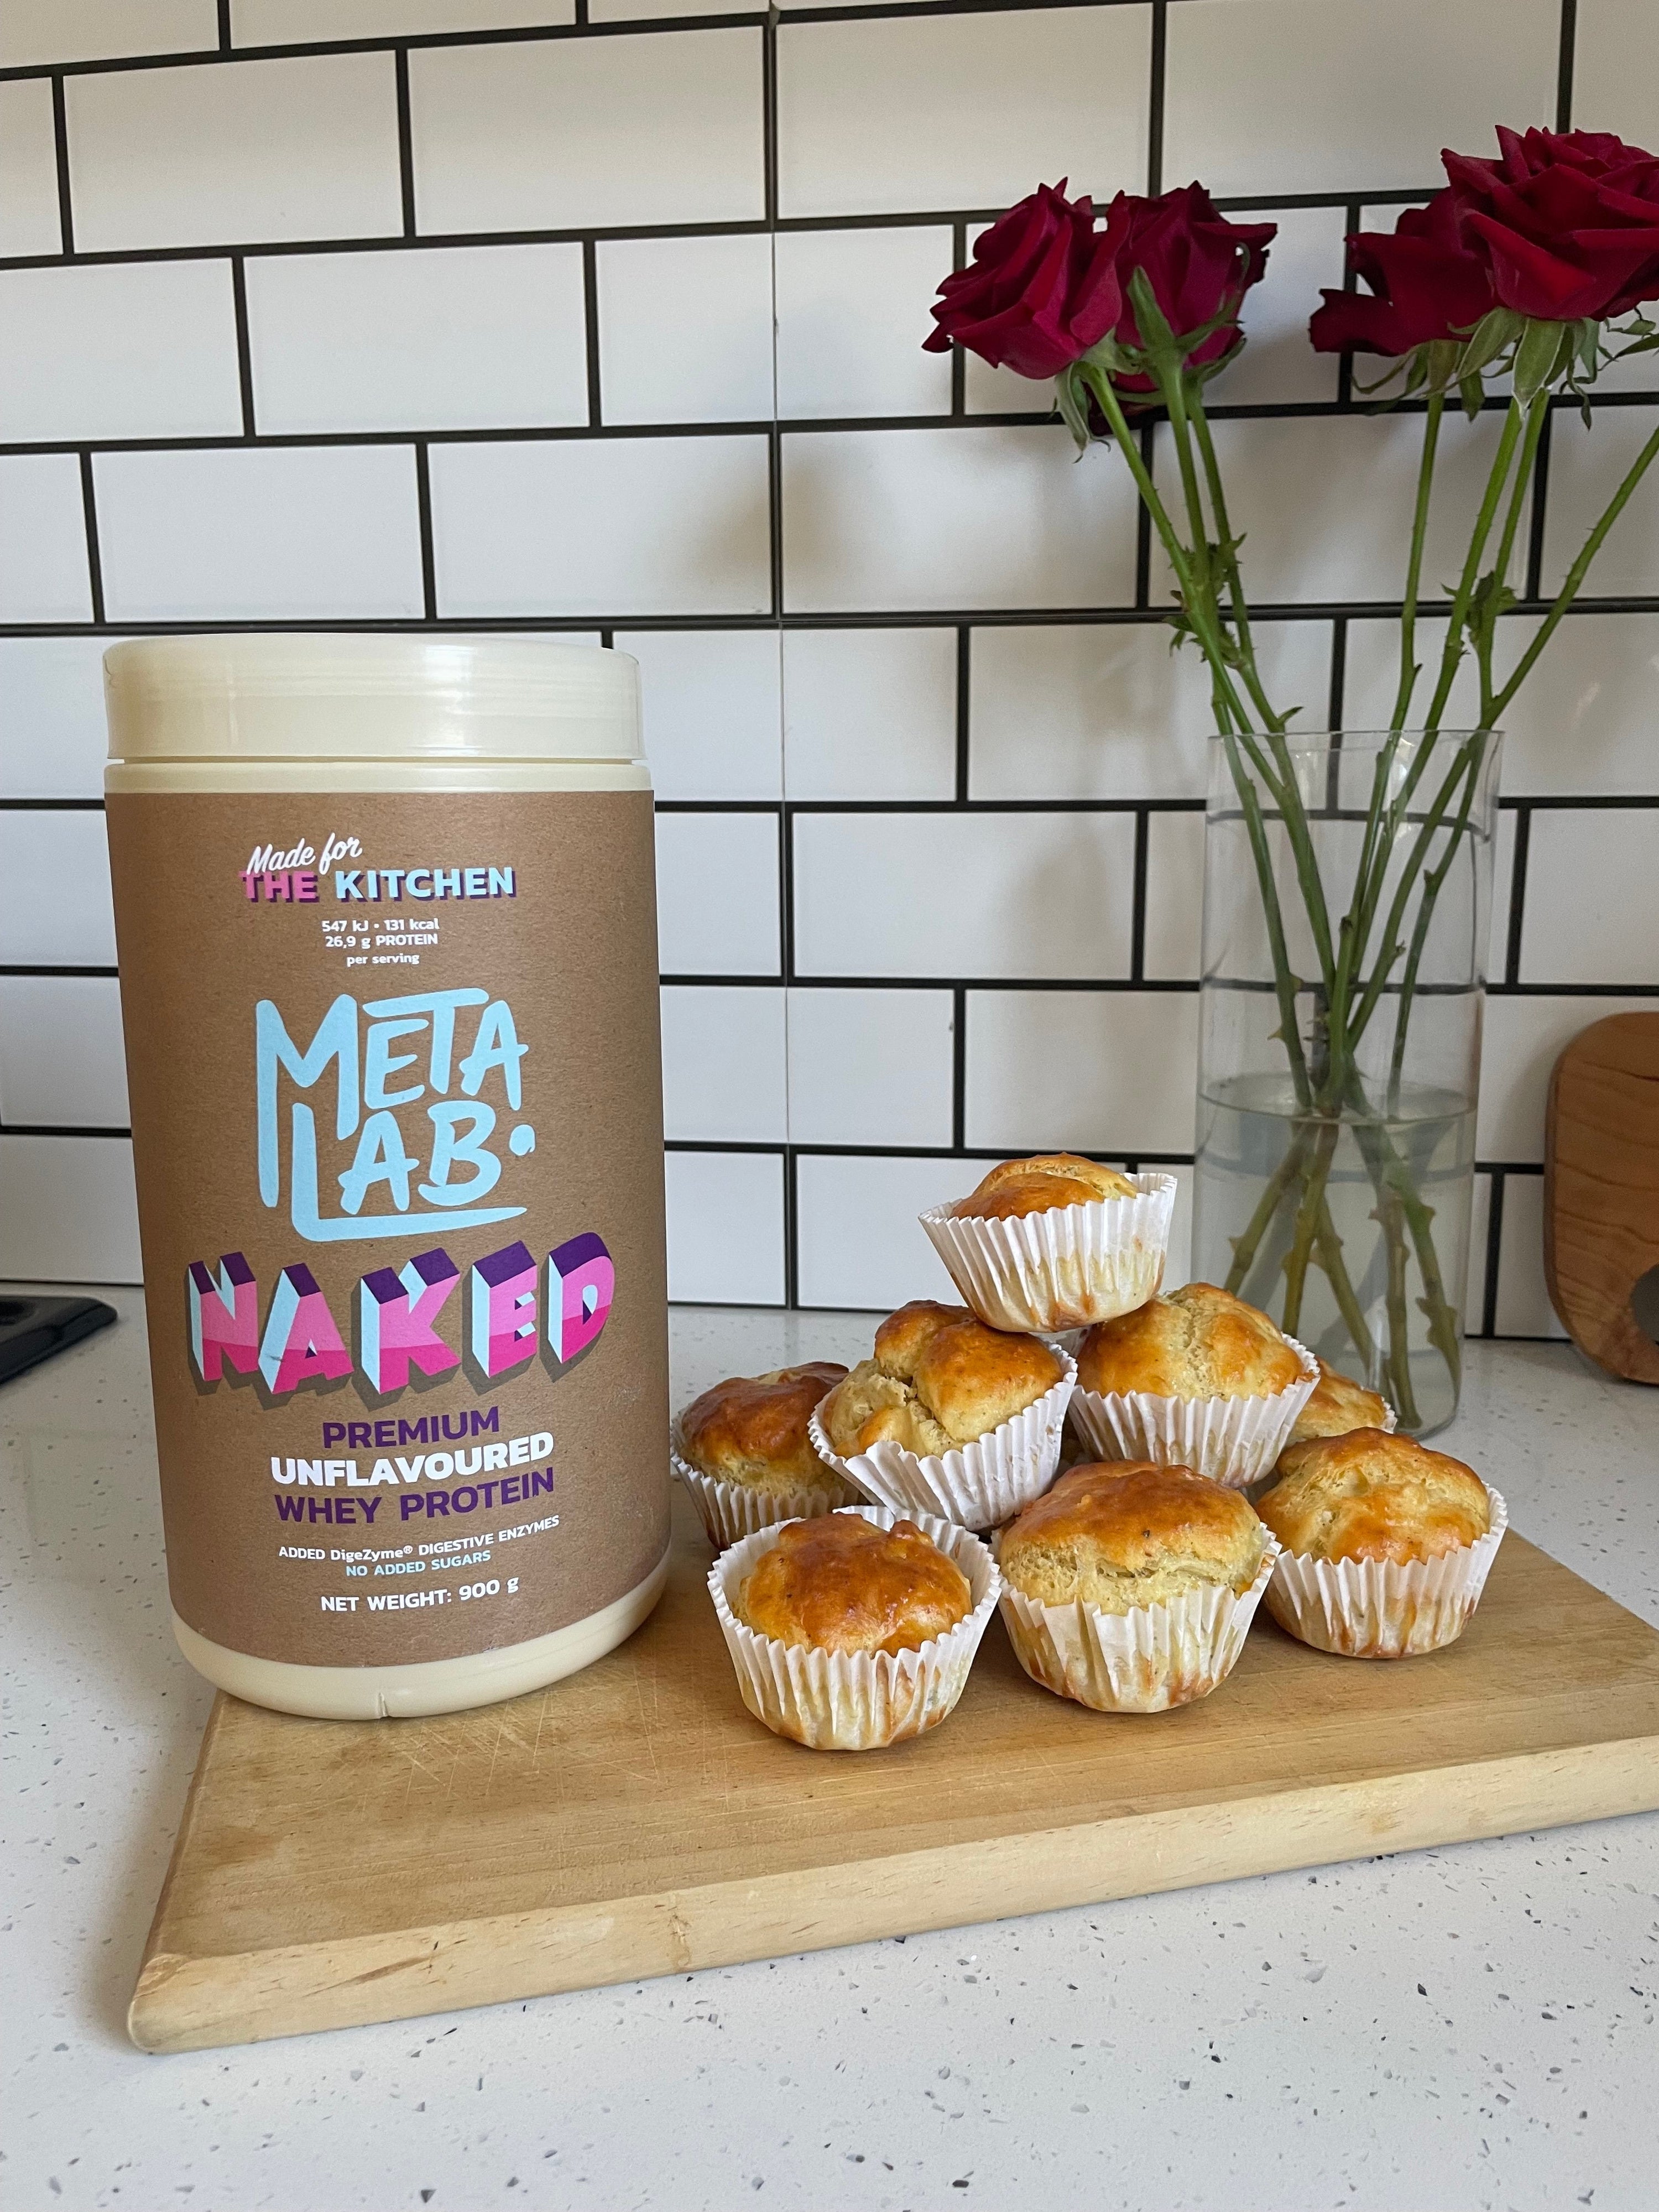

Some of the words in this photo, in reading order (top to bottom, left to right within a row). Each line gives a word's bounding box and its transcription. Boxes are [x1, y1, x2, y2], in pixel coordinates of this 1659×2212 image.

[247, 838, 316, 875] Made
[319, 833, 363, 875] for
[239, 871, 319, 902] THE
[335, 867, 516, 902] KITCHEN
[321, 920, 348, 932] 547
[352, 920, 369, 932] kJ
[383, 919, 405, 931] 131
[409, 917, 440, 931] kcal
[325, 935, 357, 949] 26,9
[361, 938, 371, 950] g
[375, 933, 439, 946] PROTEIN
[346, 956, 368, 968] per
[372, 953, 420, 965] serving
[255, 988, 529, 1208] META
[188, 1232, 615, 1395] NAKED
[322, 1406, 499, 1449] PREMIUM
[270, 1431, 555, 1487] UNFLAVOURED
[275, 1494, 383, 1525] WHEY
[400, 1467, 554, 1522] PROTEIN
[279, 1546, 326, 1560] ADDED
[418, 1532, 494, 1556] DIGESTIVE
[498, 1515, 560, 1542] ENZYMES
[346, 1565, 368, 1577] NO
[374, 1561, 426, 1575] ADDED
[431, 1550, 491, 1571] SUGARS
[321, 1596, 359, 1611] NET
[367, 1589, 452, 1611] WEIGHT:
[458, 1579, 500, 1601] 900
[507, 1577, 519, 1594] g
